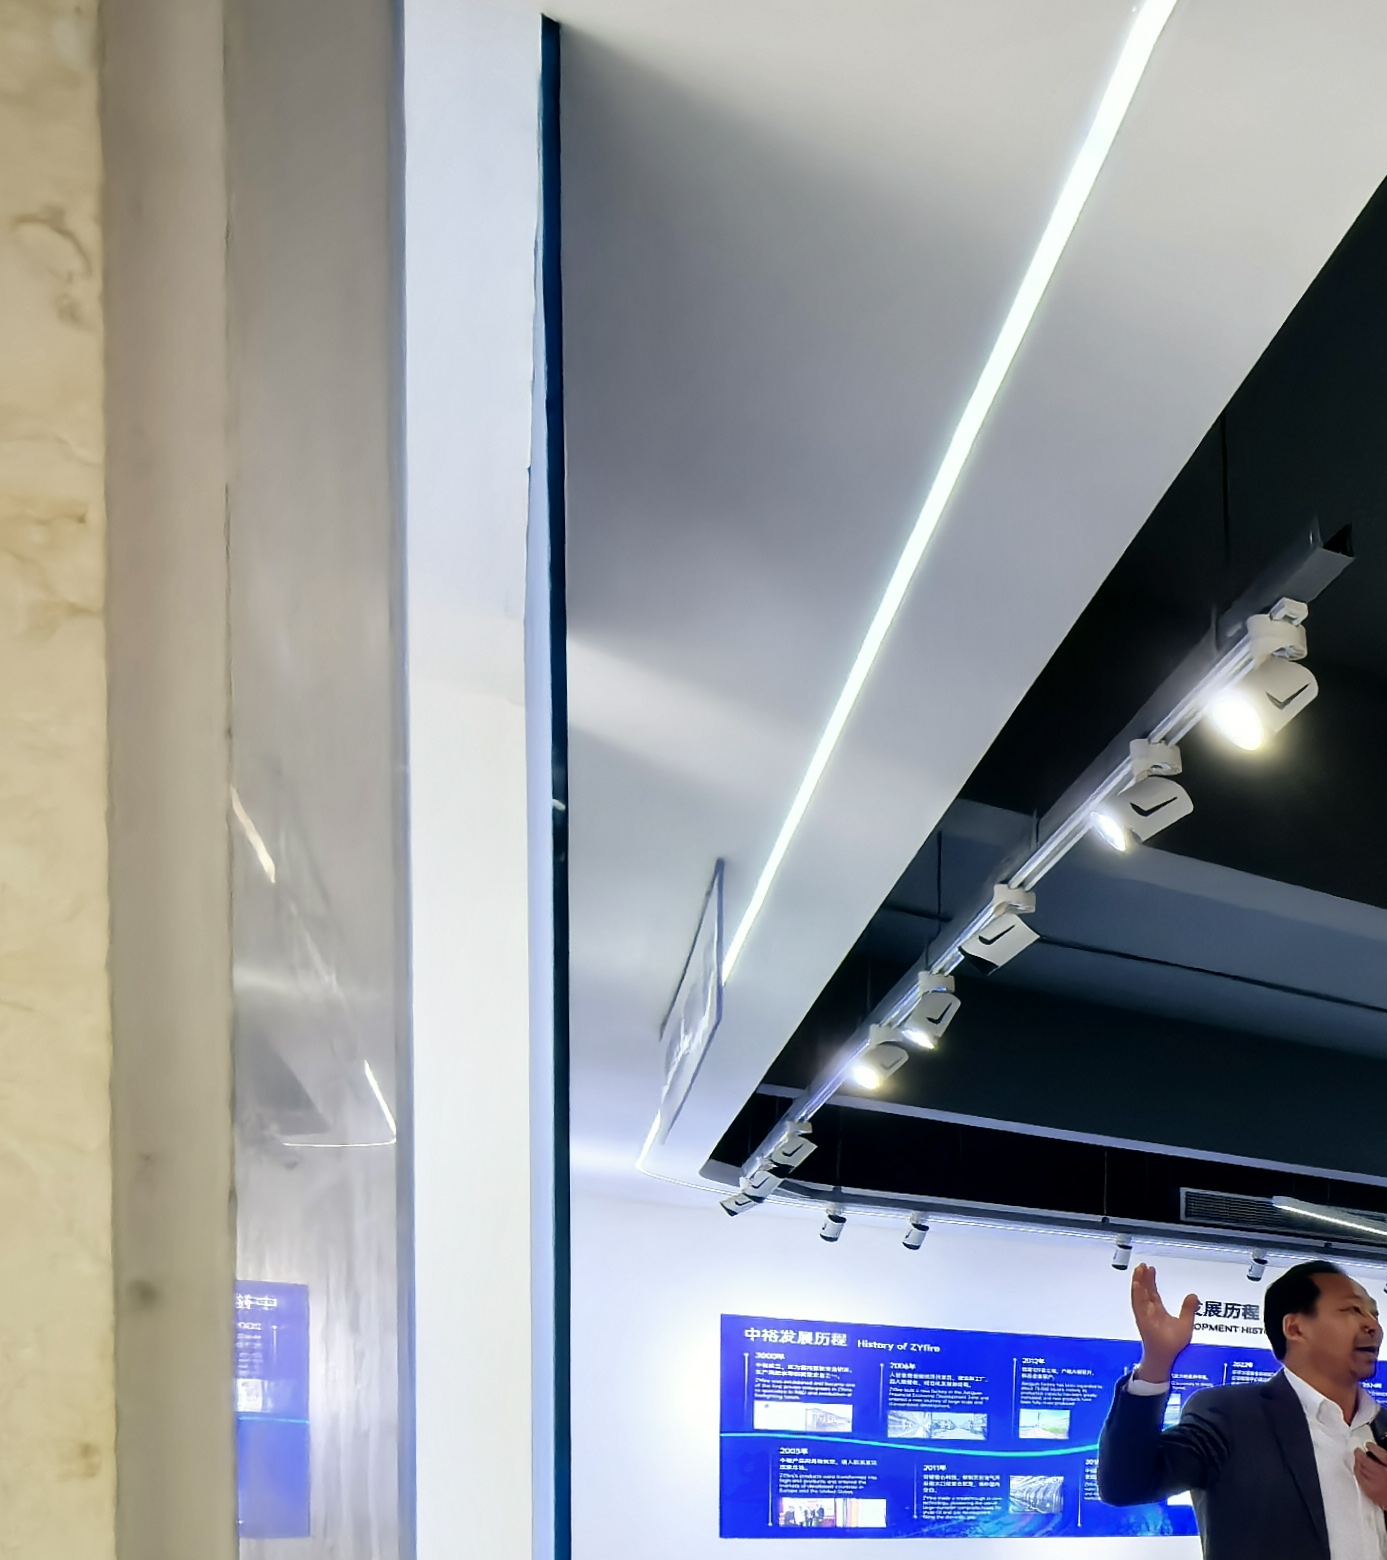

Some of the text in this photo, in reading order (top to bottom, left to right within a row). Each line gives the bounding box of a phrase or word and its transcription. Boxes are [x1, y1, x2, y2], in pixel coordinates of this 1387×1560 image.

[1241, 1326, 1266, 1335] HIST
[744, 1327, 848, 1347] 中裕发展历程
[857, 1339, 894, 1351] History
[896, 1342, 908, 1351] of
